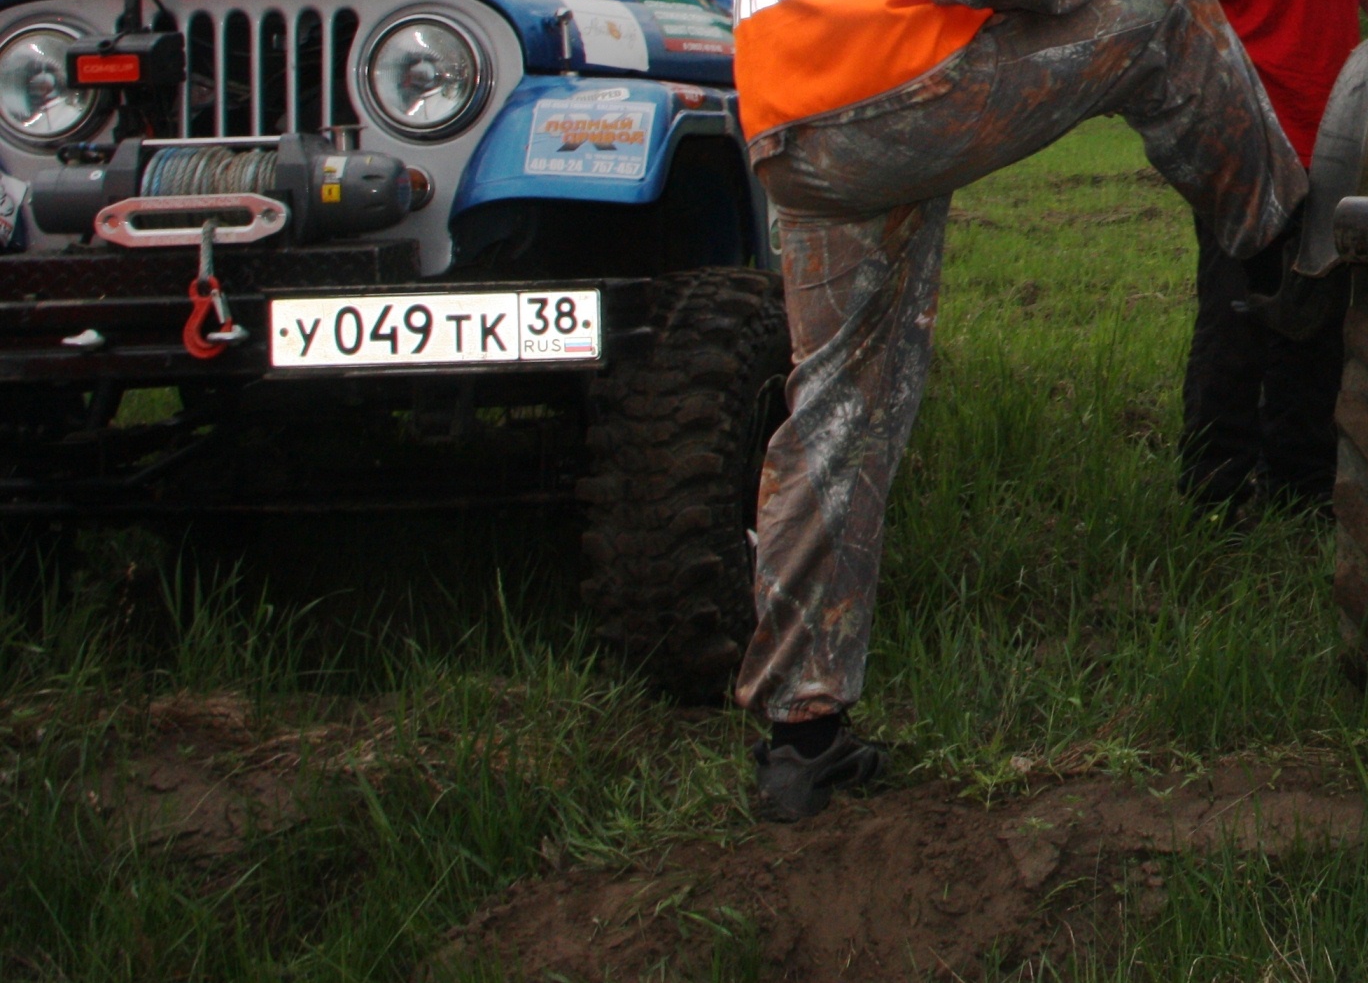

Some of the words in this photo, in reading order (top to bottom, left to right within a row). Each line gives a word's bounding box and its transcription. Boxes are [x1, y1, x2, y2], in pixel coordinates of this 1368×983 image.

[545, 117, 634, 133] ПОЛНЫЙ
[562, 131, 646, 146] ПРИВОД
[527, 297, 578, 335] 38
[524, 339, 562, 353] RUS
